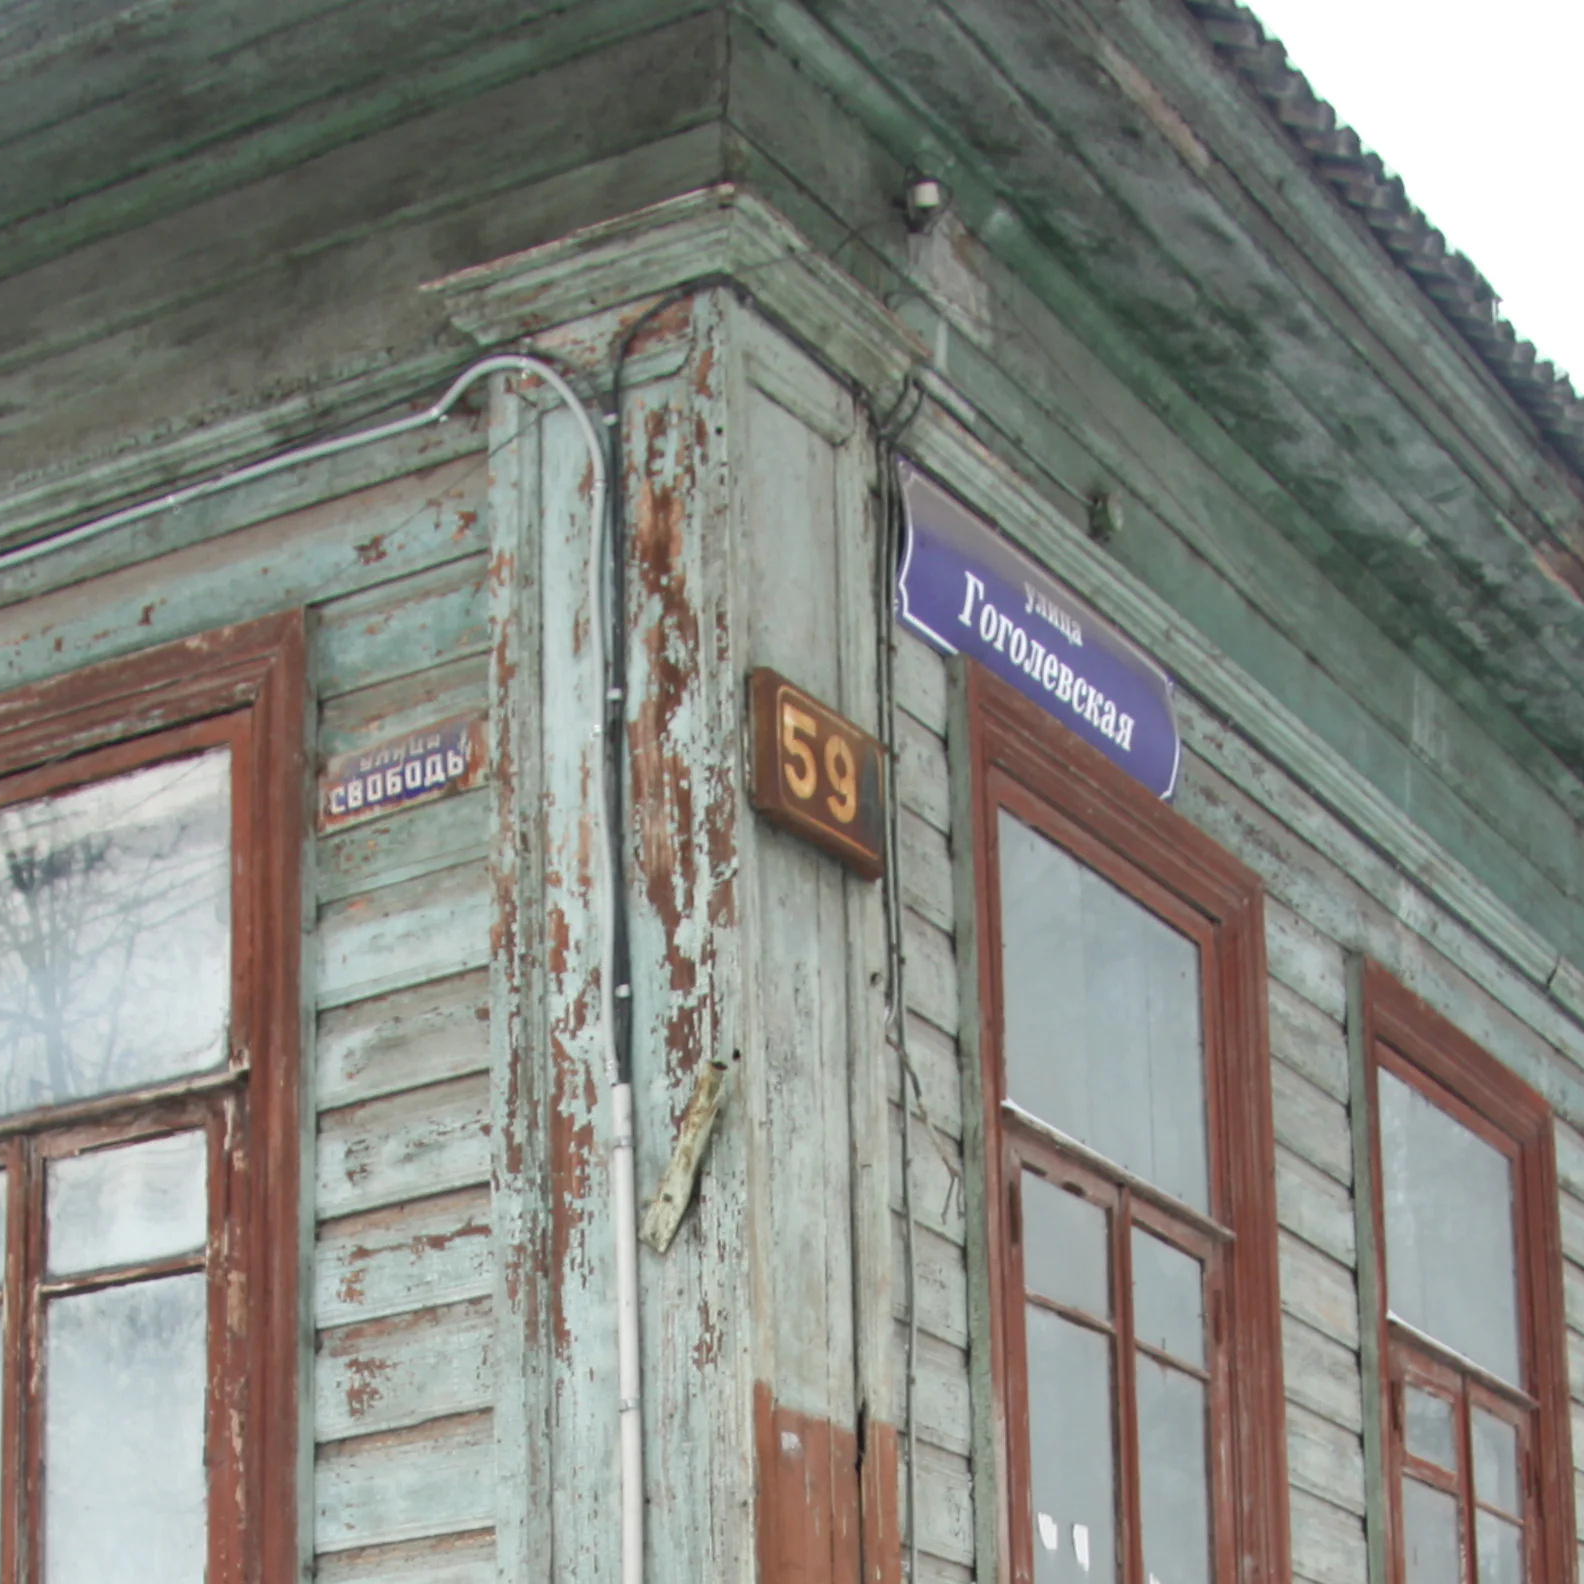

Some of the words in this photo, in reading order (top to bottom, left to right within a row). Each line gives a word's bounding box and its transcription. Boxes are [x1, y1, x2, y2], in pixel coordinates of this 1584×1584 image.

[958, 571, 1135, 752] Гоголевская
[1024, 582, 1083, 646] улица
[783, 703, 857, 824] 59
